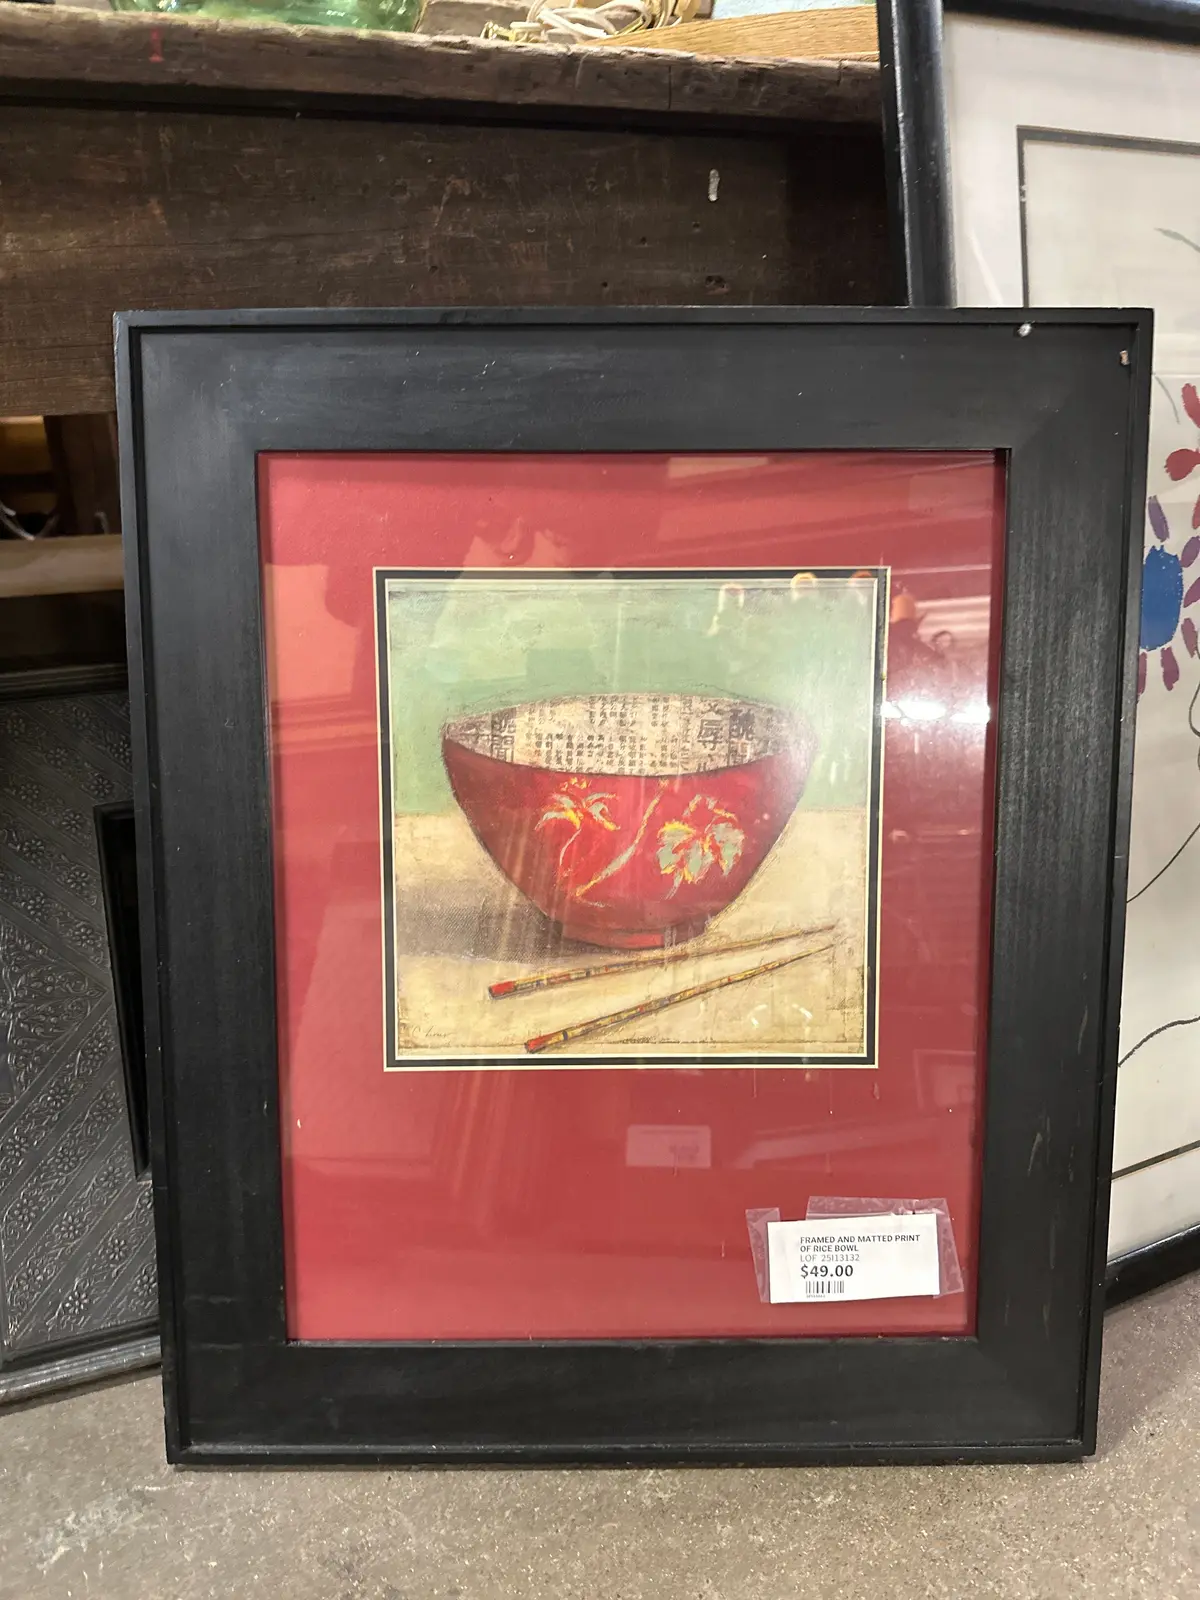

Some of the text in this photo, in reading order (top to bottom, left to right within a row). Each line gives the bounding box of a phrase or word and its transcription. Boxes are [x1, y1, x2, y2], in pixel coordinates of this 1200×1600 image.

[800, 1236, 835, 1244] FRAMED
[858, 1234, 893, 1243] MATTED
[895, 1234, 920, 1242] PRINT
[800, 1245, 811, 1253] OF
[834, 1244, 859, 1252] BOWL
[800, 1254, 817, 1262] LOF
[800, 1264, 854, 1279] $49.00
